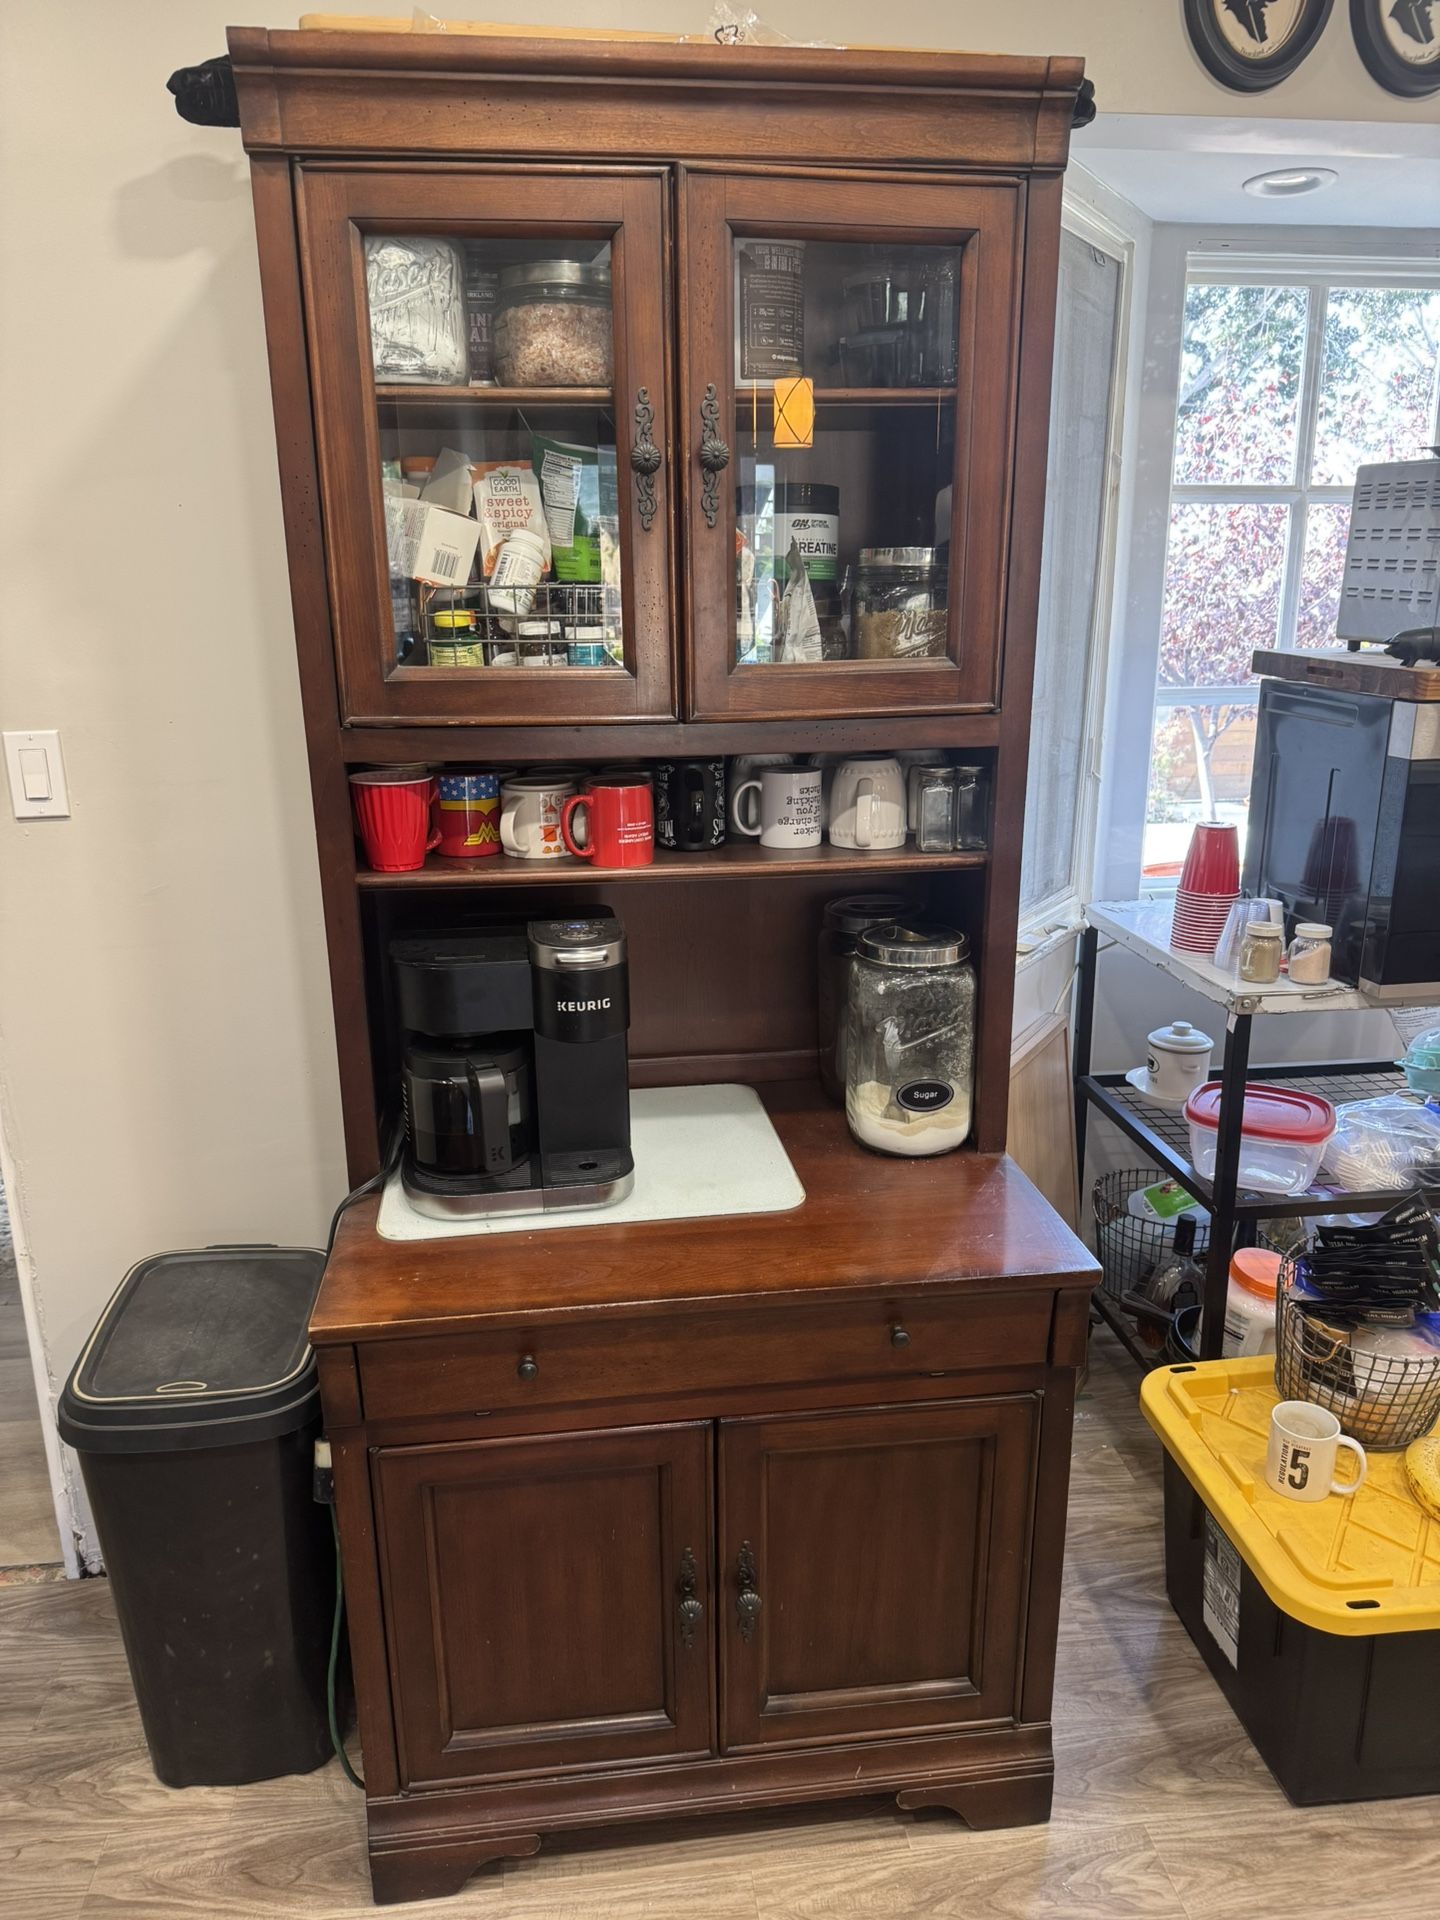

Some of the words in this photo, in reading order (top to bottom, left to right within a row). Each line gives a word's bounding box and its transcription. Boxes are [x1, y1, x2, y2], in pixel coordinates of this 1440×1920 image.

[493, 478, 518, 486] GOOD
[487, 496, 530, 507] sweet
[491, 519, 528, 529] original
[798, 541, 837, 556] REATINE
[796, 803, 813, 816] you
[777, 816, 812, 826] charge
[556, 997, 611, 1012] KEURIG
[913, 1090, 939, 1100] Sugar
[1277, 1442, 1290, 1485] REGULATION
[1287, 1447, 1311, 1490] 5
